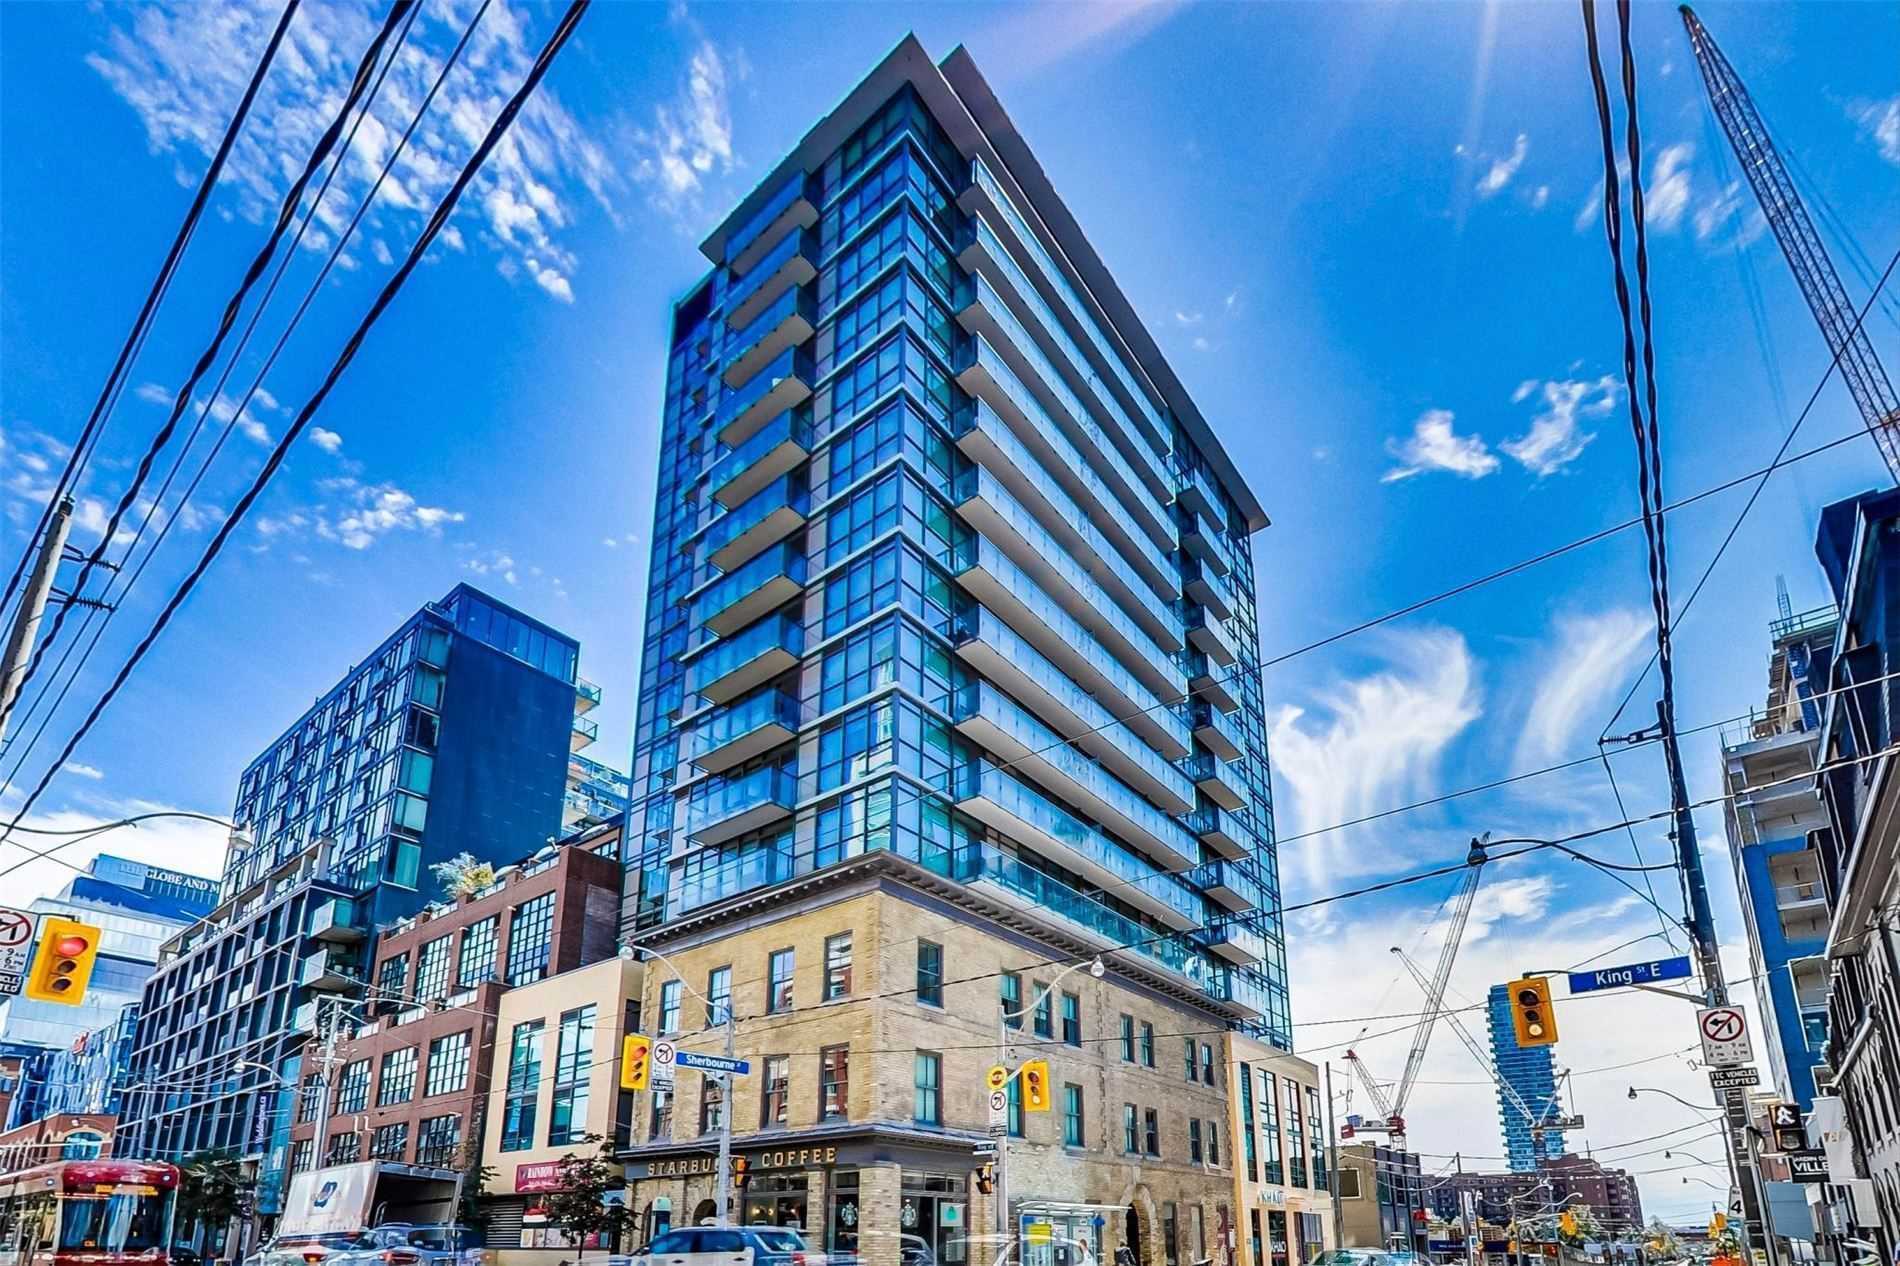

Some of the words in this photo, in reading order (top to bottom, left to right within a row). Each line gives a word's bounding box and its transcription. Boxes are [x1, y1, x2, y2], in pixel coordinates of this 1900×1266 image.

[145, 869, 182, 885] GLOBE
[184, 876, 208, 890] AND
[1596, 970, 1633, 985] King
[1650, 963, 1661, 977] E
[686, 1055, 735, 1070] Sherbourne
[1714, 1077, 1757, 1087] EXCEPTED
[761, 1147, 837, 1167] COFFEE
[1793, 1160, 1829, 1172] VILLE
